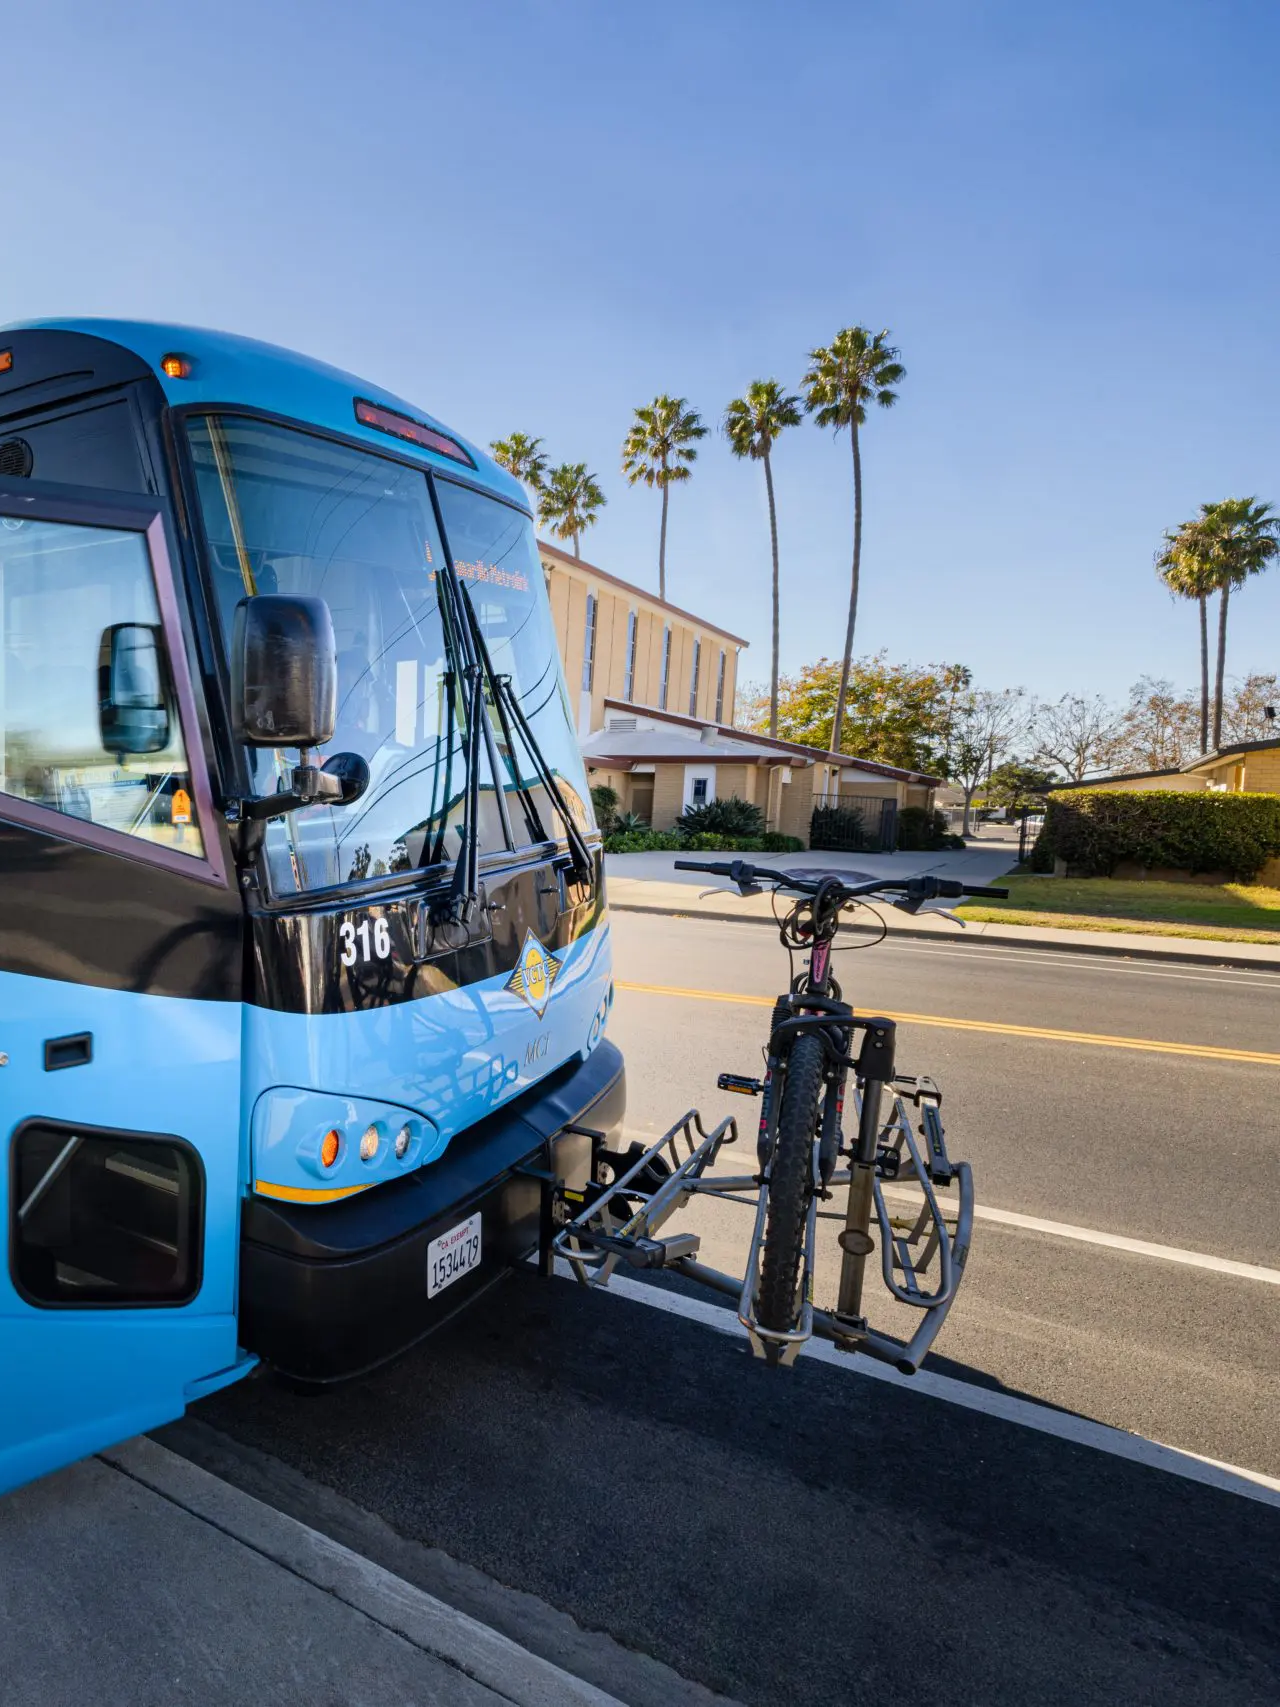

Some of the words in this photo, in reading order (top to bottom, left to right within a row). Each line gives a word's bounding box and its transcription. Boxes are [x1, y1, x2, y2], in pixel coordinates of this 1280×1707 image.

[339, 917, 391, 967] 316
[521, 959, 550, 988] VCTC
[523, 1030, 552, 1068] MCI
[440, 1240, 449, 1250] CA
[450, 1226, 470, 1245] EXEMPT
[432, 1234, 479, 1289] 1534479
